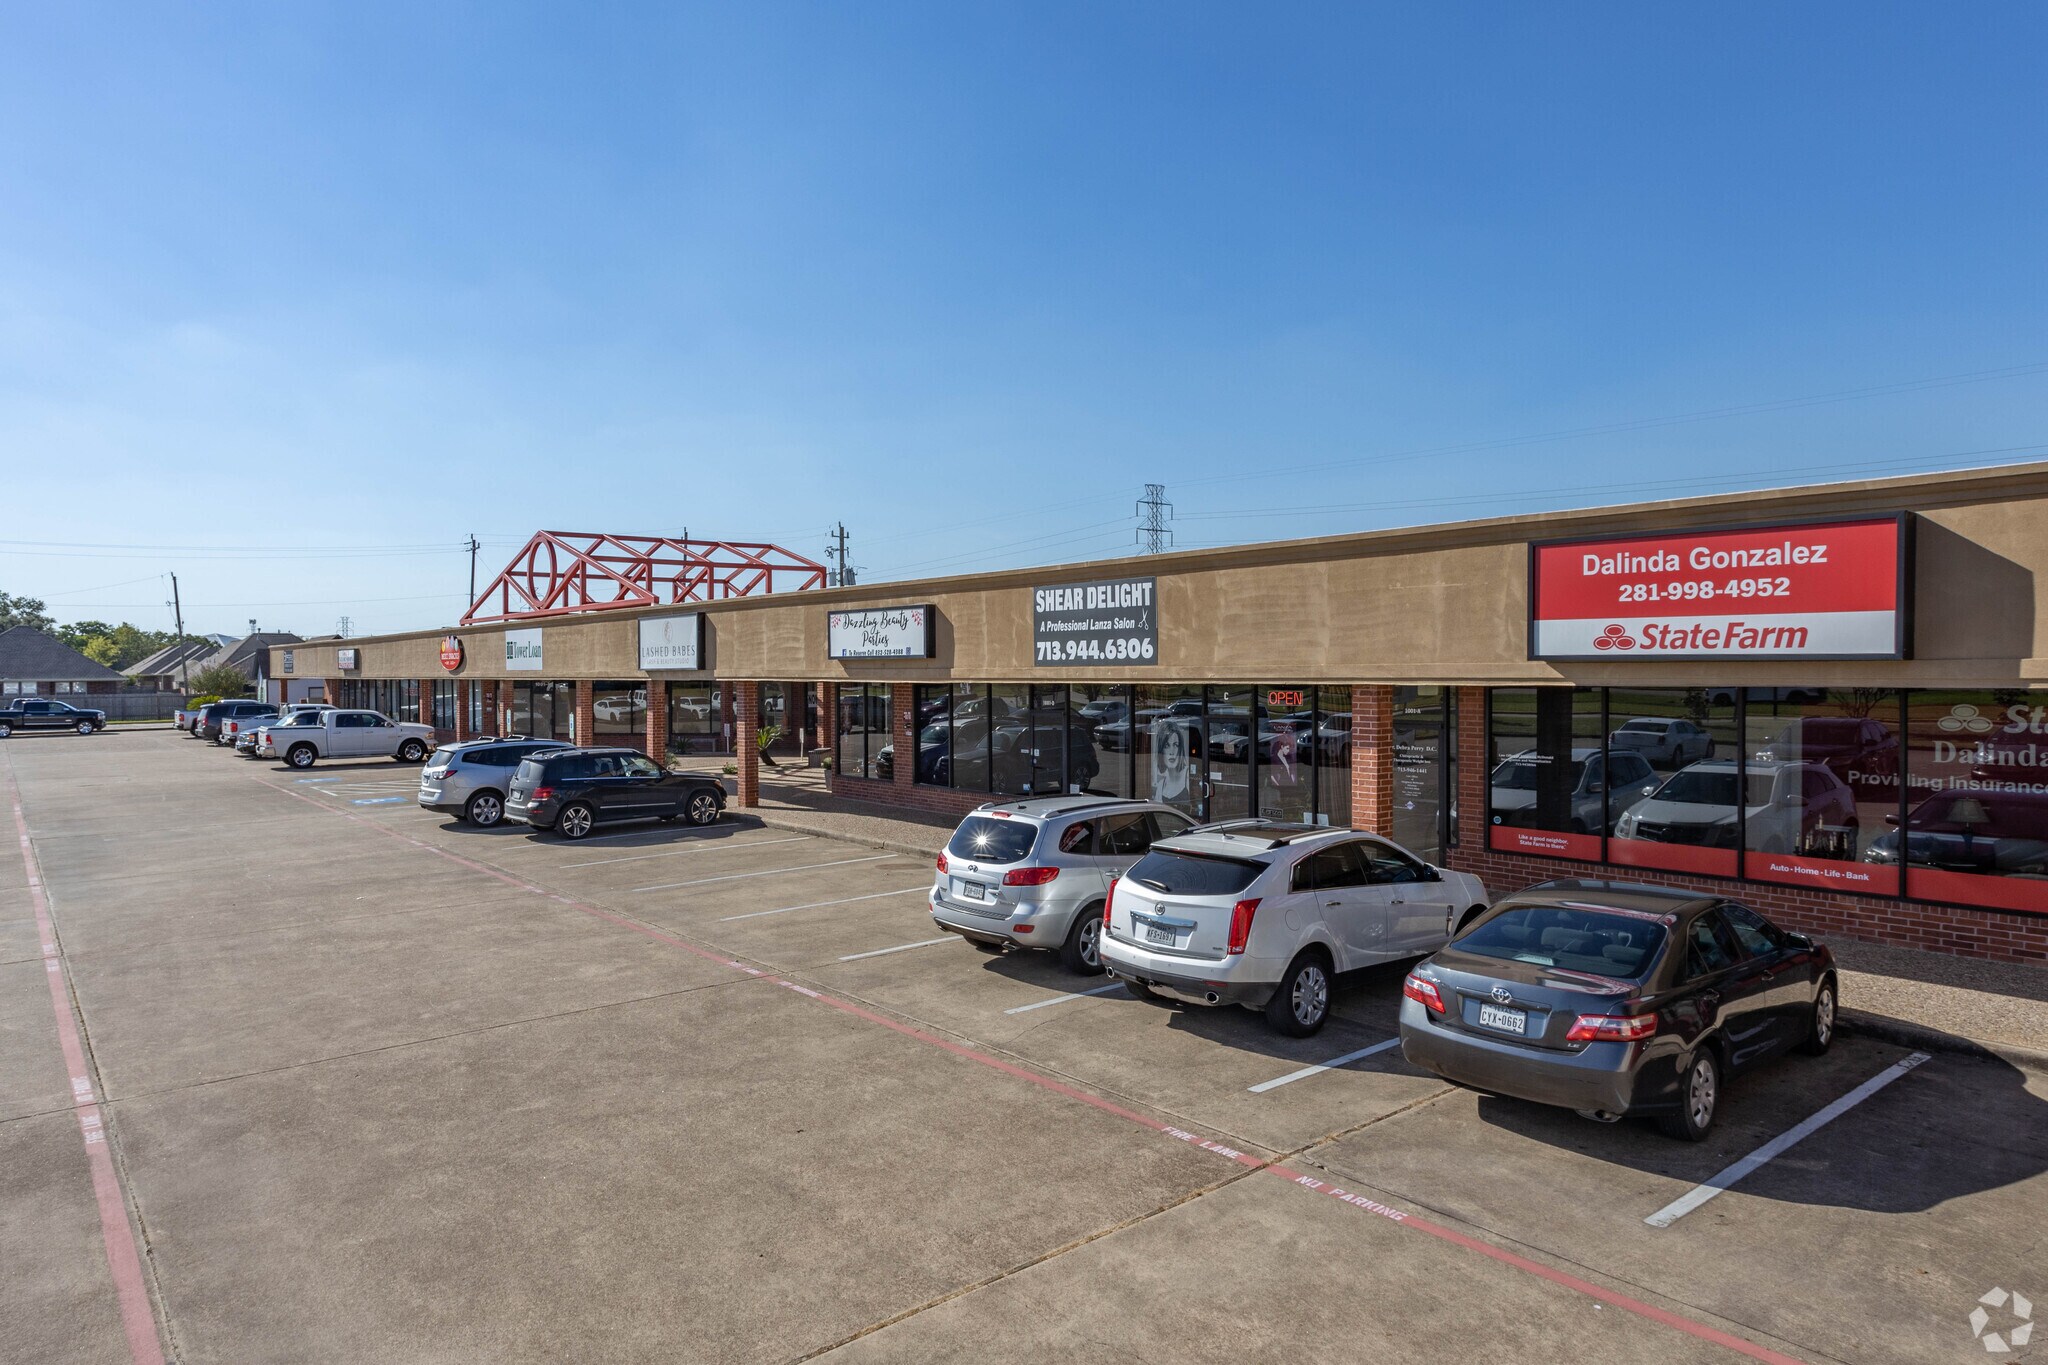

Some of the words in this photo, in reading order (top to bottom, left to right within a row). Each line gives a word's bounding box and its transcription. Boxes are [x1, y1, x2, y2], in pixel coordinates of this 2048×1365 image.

[1582, 551, 1680, 576] Dalinda
[1689, 542, 1827, 570] Gonzalez
[1036, 587, 1083, 612] SHEAR
[1087, 582, 1152, 609] DELIGHT
[1619, 577, 1790, 602] 281-998-4952
[843, 613, 878, 634] Dazzling
[880, 610, 909, 630] Beauty
[1040, 621, 1045, 632] A
[1047, 618, 1089, 632] Professional
[1090, 618, 1112, 630] Lanza
[1113, 617, 1135, 629] Salon
[862, 630, 889, 647] Parties
[1037, 638, 1154, 660] 713.944.6306
[642, 646, 669, 657] LASHED
[672, 645, 695, 656] BABES
[1223, 692, 1229, 701] C
[1269, 691, 1303, 706] OPEN
[2003, 705, 2048, 734] St
[1932, 741, 2048, 767] Dalinda
[1770, 863, 1790, 872] Auto
[1794, 866, 1819, 876] Home
[1824, 869, 1841, 878] Life
[1846, 872, 1870, 881] Bank
[1161, 1126, 1197, 1142] FIRE
[1199, 1140, 1243, 1159] LANE
[1295, 1176, 1322, 1189] NO
[1328, 1188, 1408, 1221] PARKING
